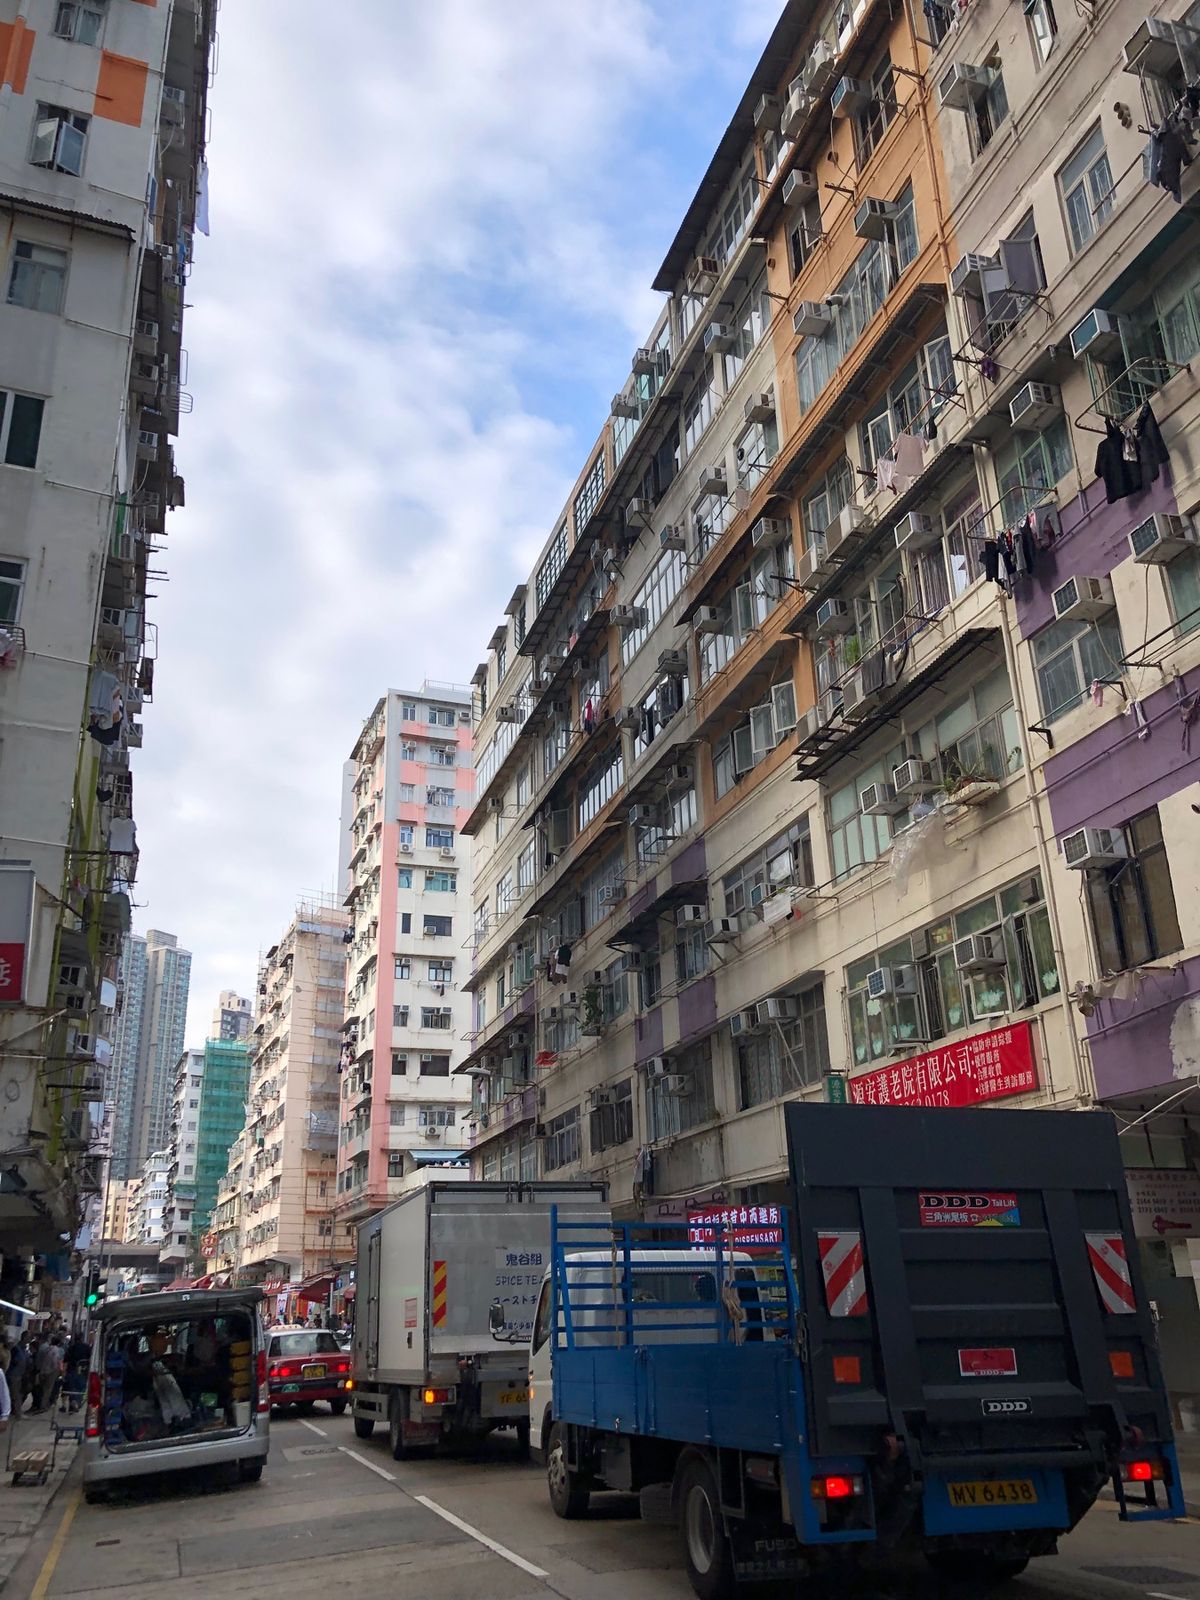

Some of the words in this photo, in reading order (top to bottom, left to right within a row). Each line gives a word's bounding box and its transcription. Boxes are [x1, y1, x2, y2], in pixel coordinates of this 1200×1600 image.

[919, 1194, 991, 1209] DDD
[495, 1275, 523, 1286] SPICE
[988, 1401, 1027, 1412] DDD
[952, 1485, 977, 1504] MV
[983, 1483, 1033, 1502] 6438
